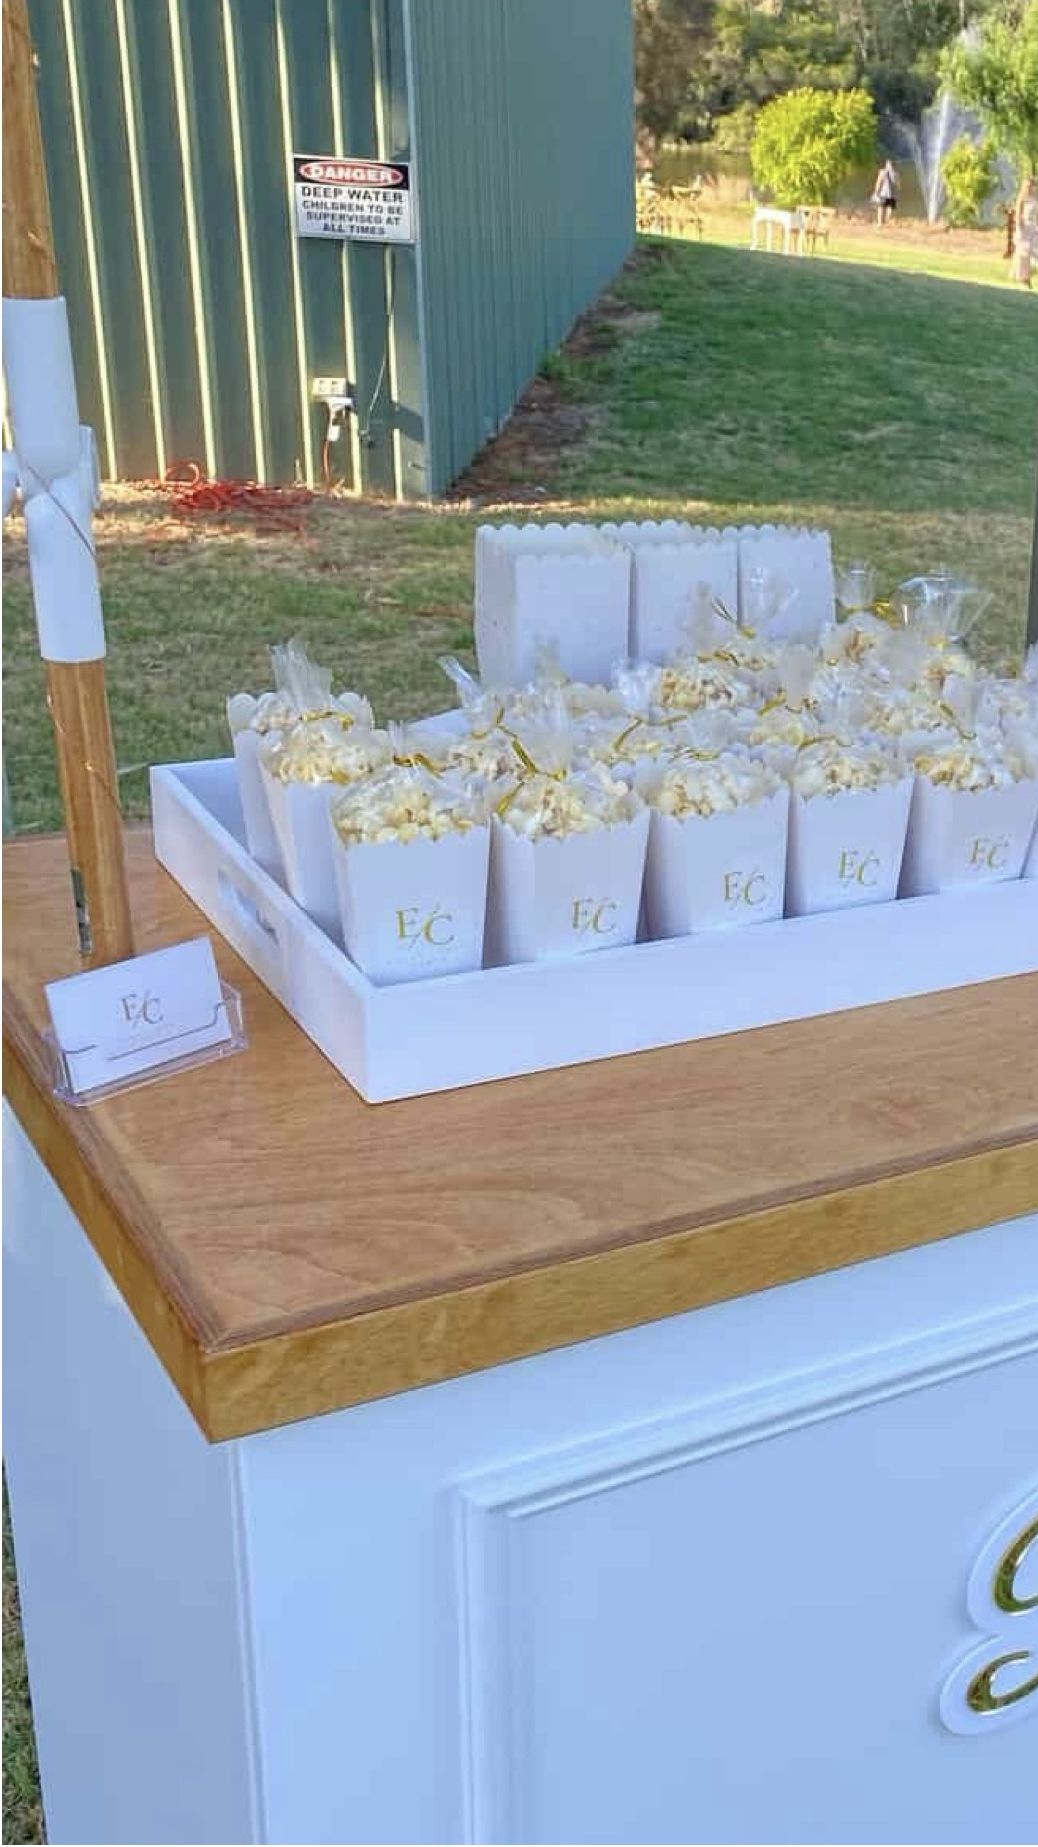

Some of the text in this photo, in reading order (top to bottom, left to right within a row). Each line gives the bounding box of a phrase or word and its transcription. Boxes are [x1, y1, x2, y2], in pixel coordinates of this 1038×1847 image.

[312, 166, 389, 180] DANGER
[302, 187, 403, 202] DEEP WATER
[303, 201, 403, 215] CHILDREN TO BE
[307, 212, 382, 224] SUPERVISED
[323, 223, 385, 234] ALL TIMES
